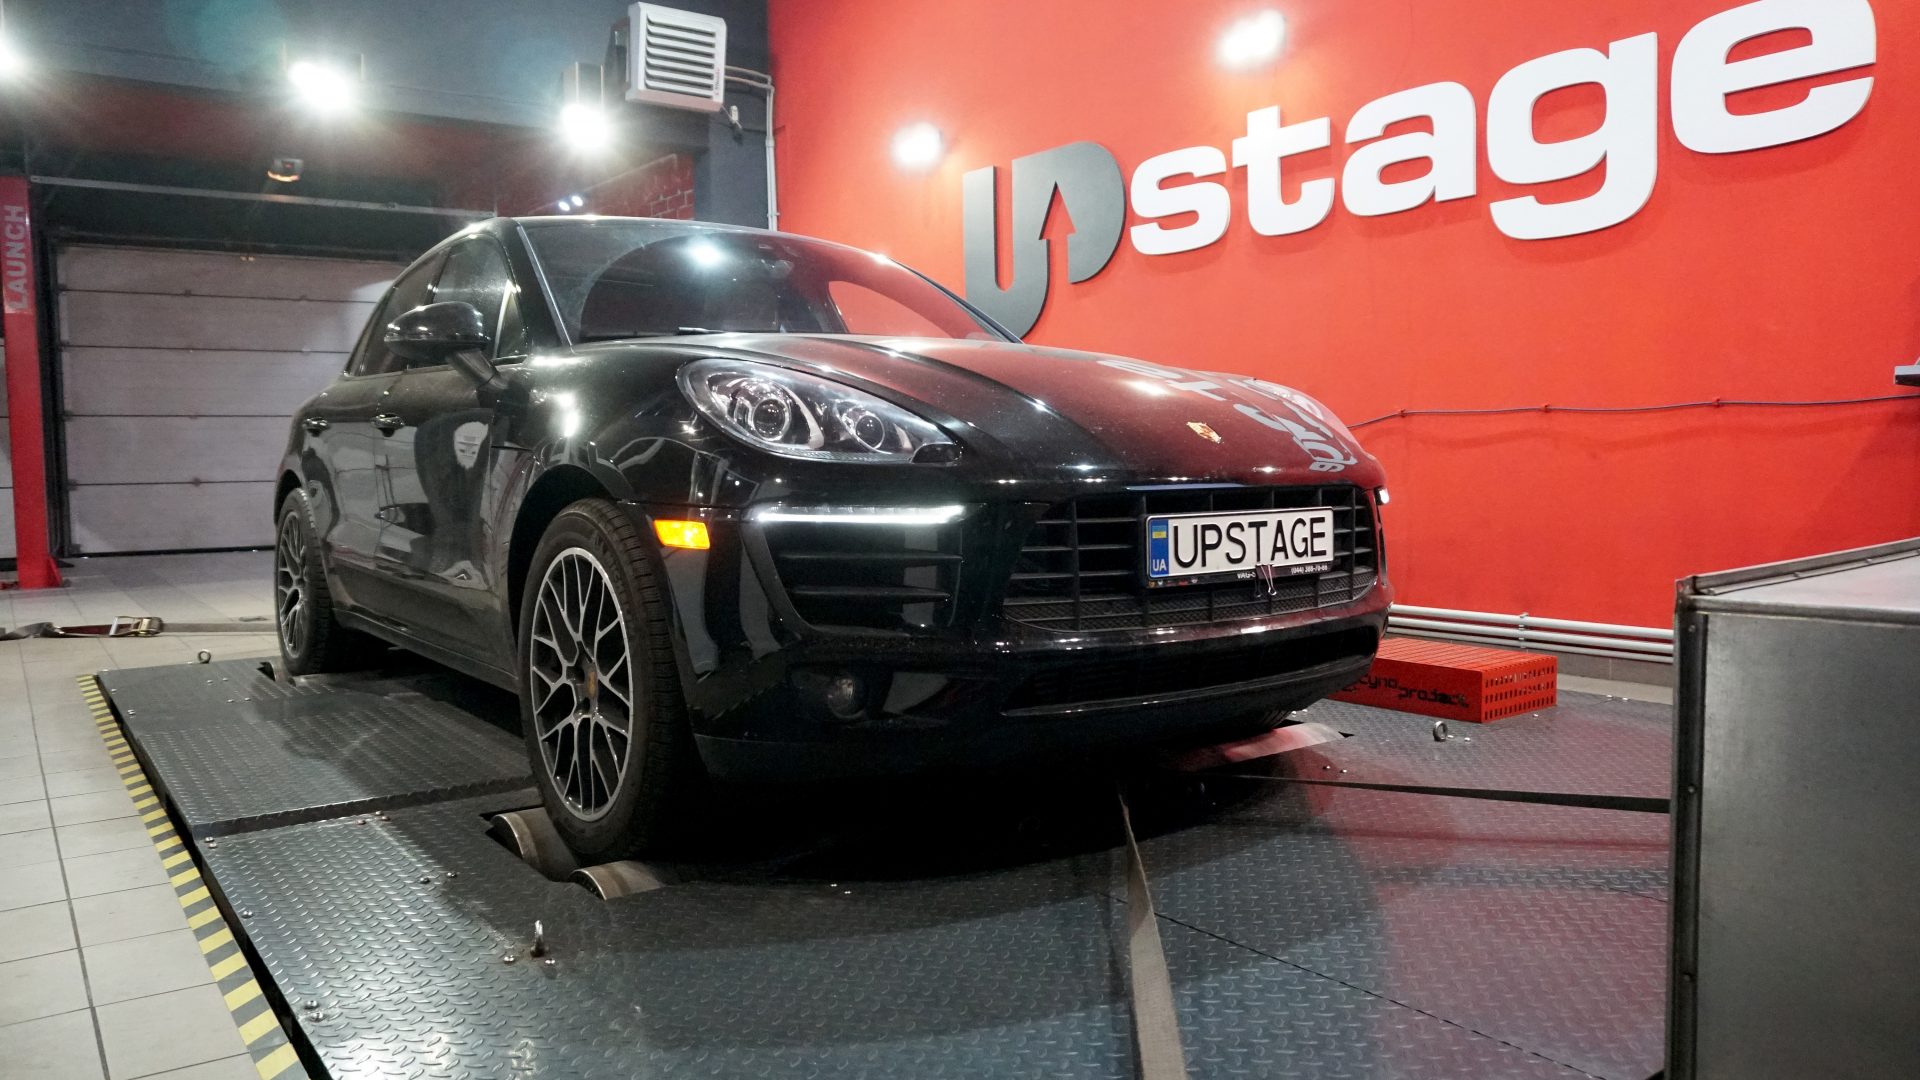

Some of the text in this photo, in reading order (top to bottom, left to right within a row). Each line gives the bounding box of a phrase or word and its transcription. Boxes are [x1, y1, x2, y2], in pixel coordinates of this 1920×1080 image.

[3, 204, 28, 311] LAUNCH
[1152, 558, 1167, 572] UA
[1173, 516, 1327, 568] UPSTAGE
